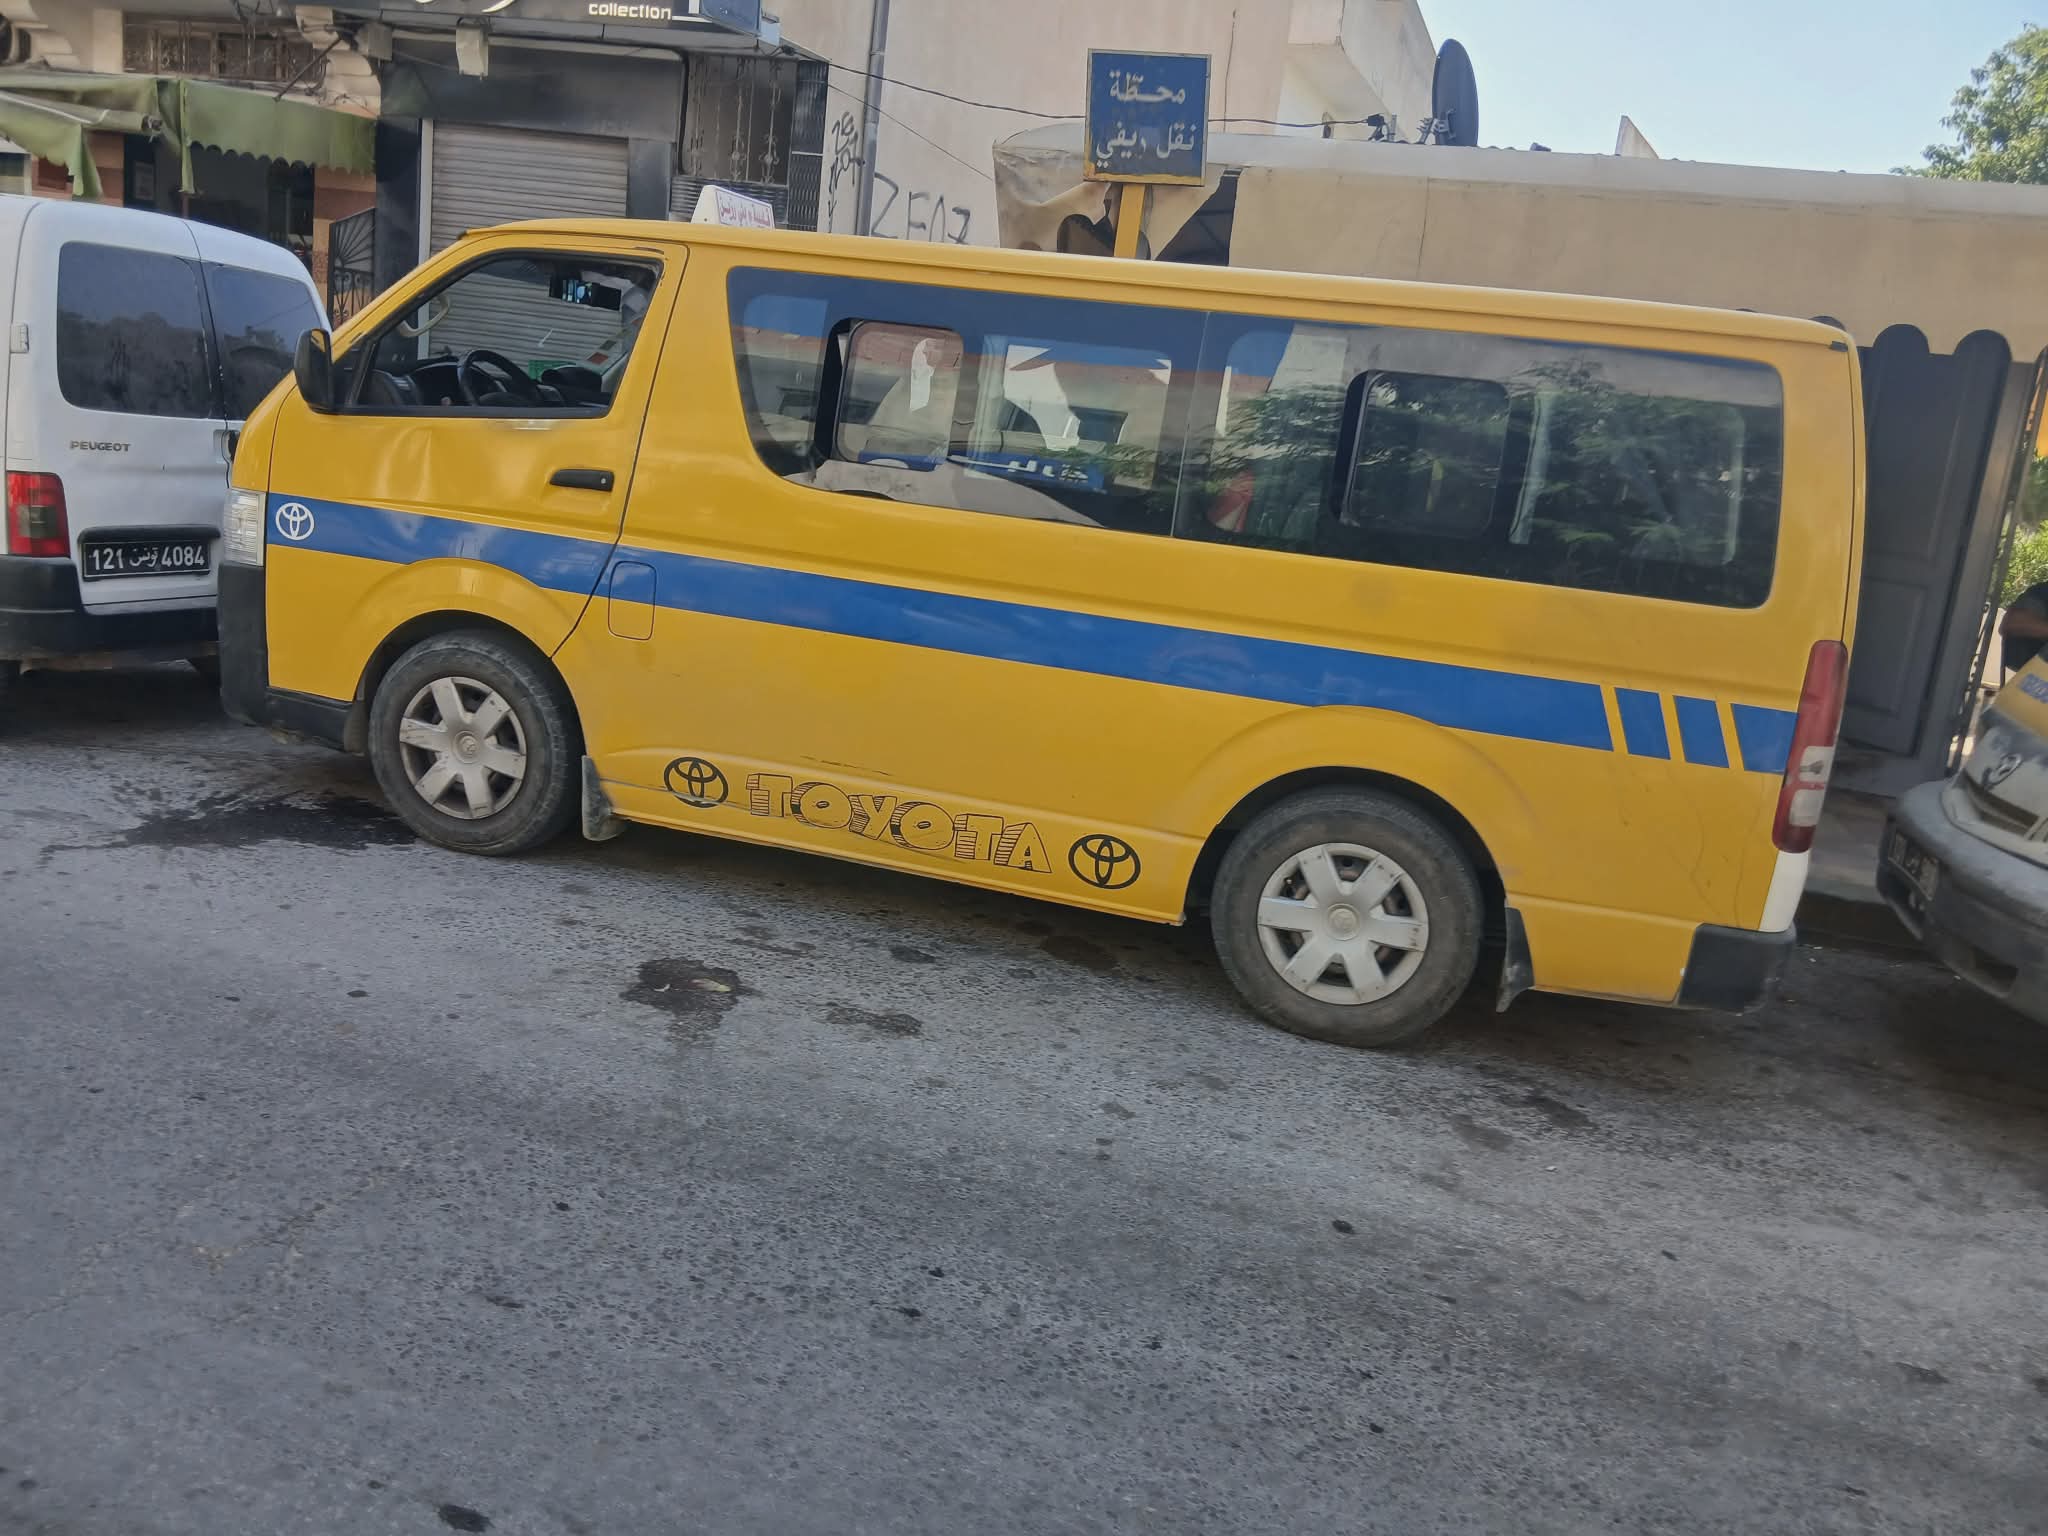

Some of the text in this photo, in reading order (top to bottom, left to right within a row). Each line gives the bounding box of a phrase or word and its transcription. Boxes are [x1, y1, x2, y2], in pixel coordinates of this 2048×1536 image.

[588, 2, 672, 20] collection
[1096, 121, 1197, 168] نقل ريفي
[70, 440, 131, 452] PEUGEOT
[92, 545, 205, 570] 121 تونس 4084
[745, 772, 1053, 874] TOYOTA
